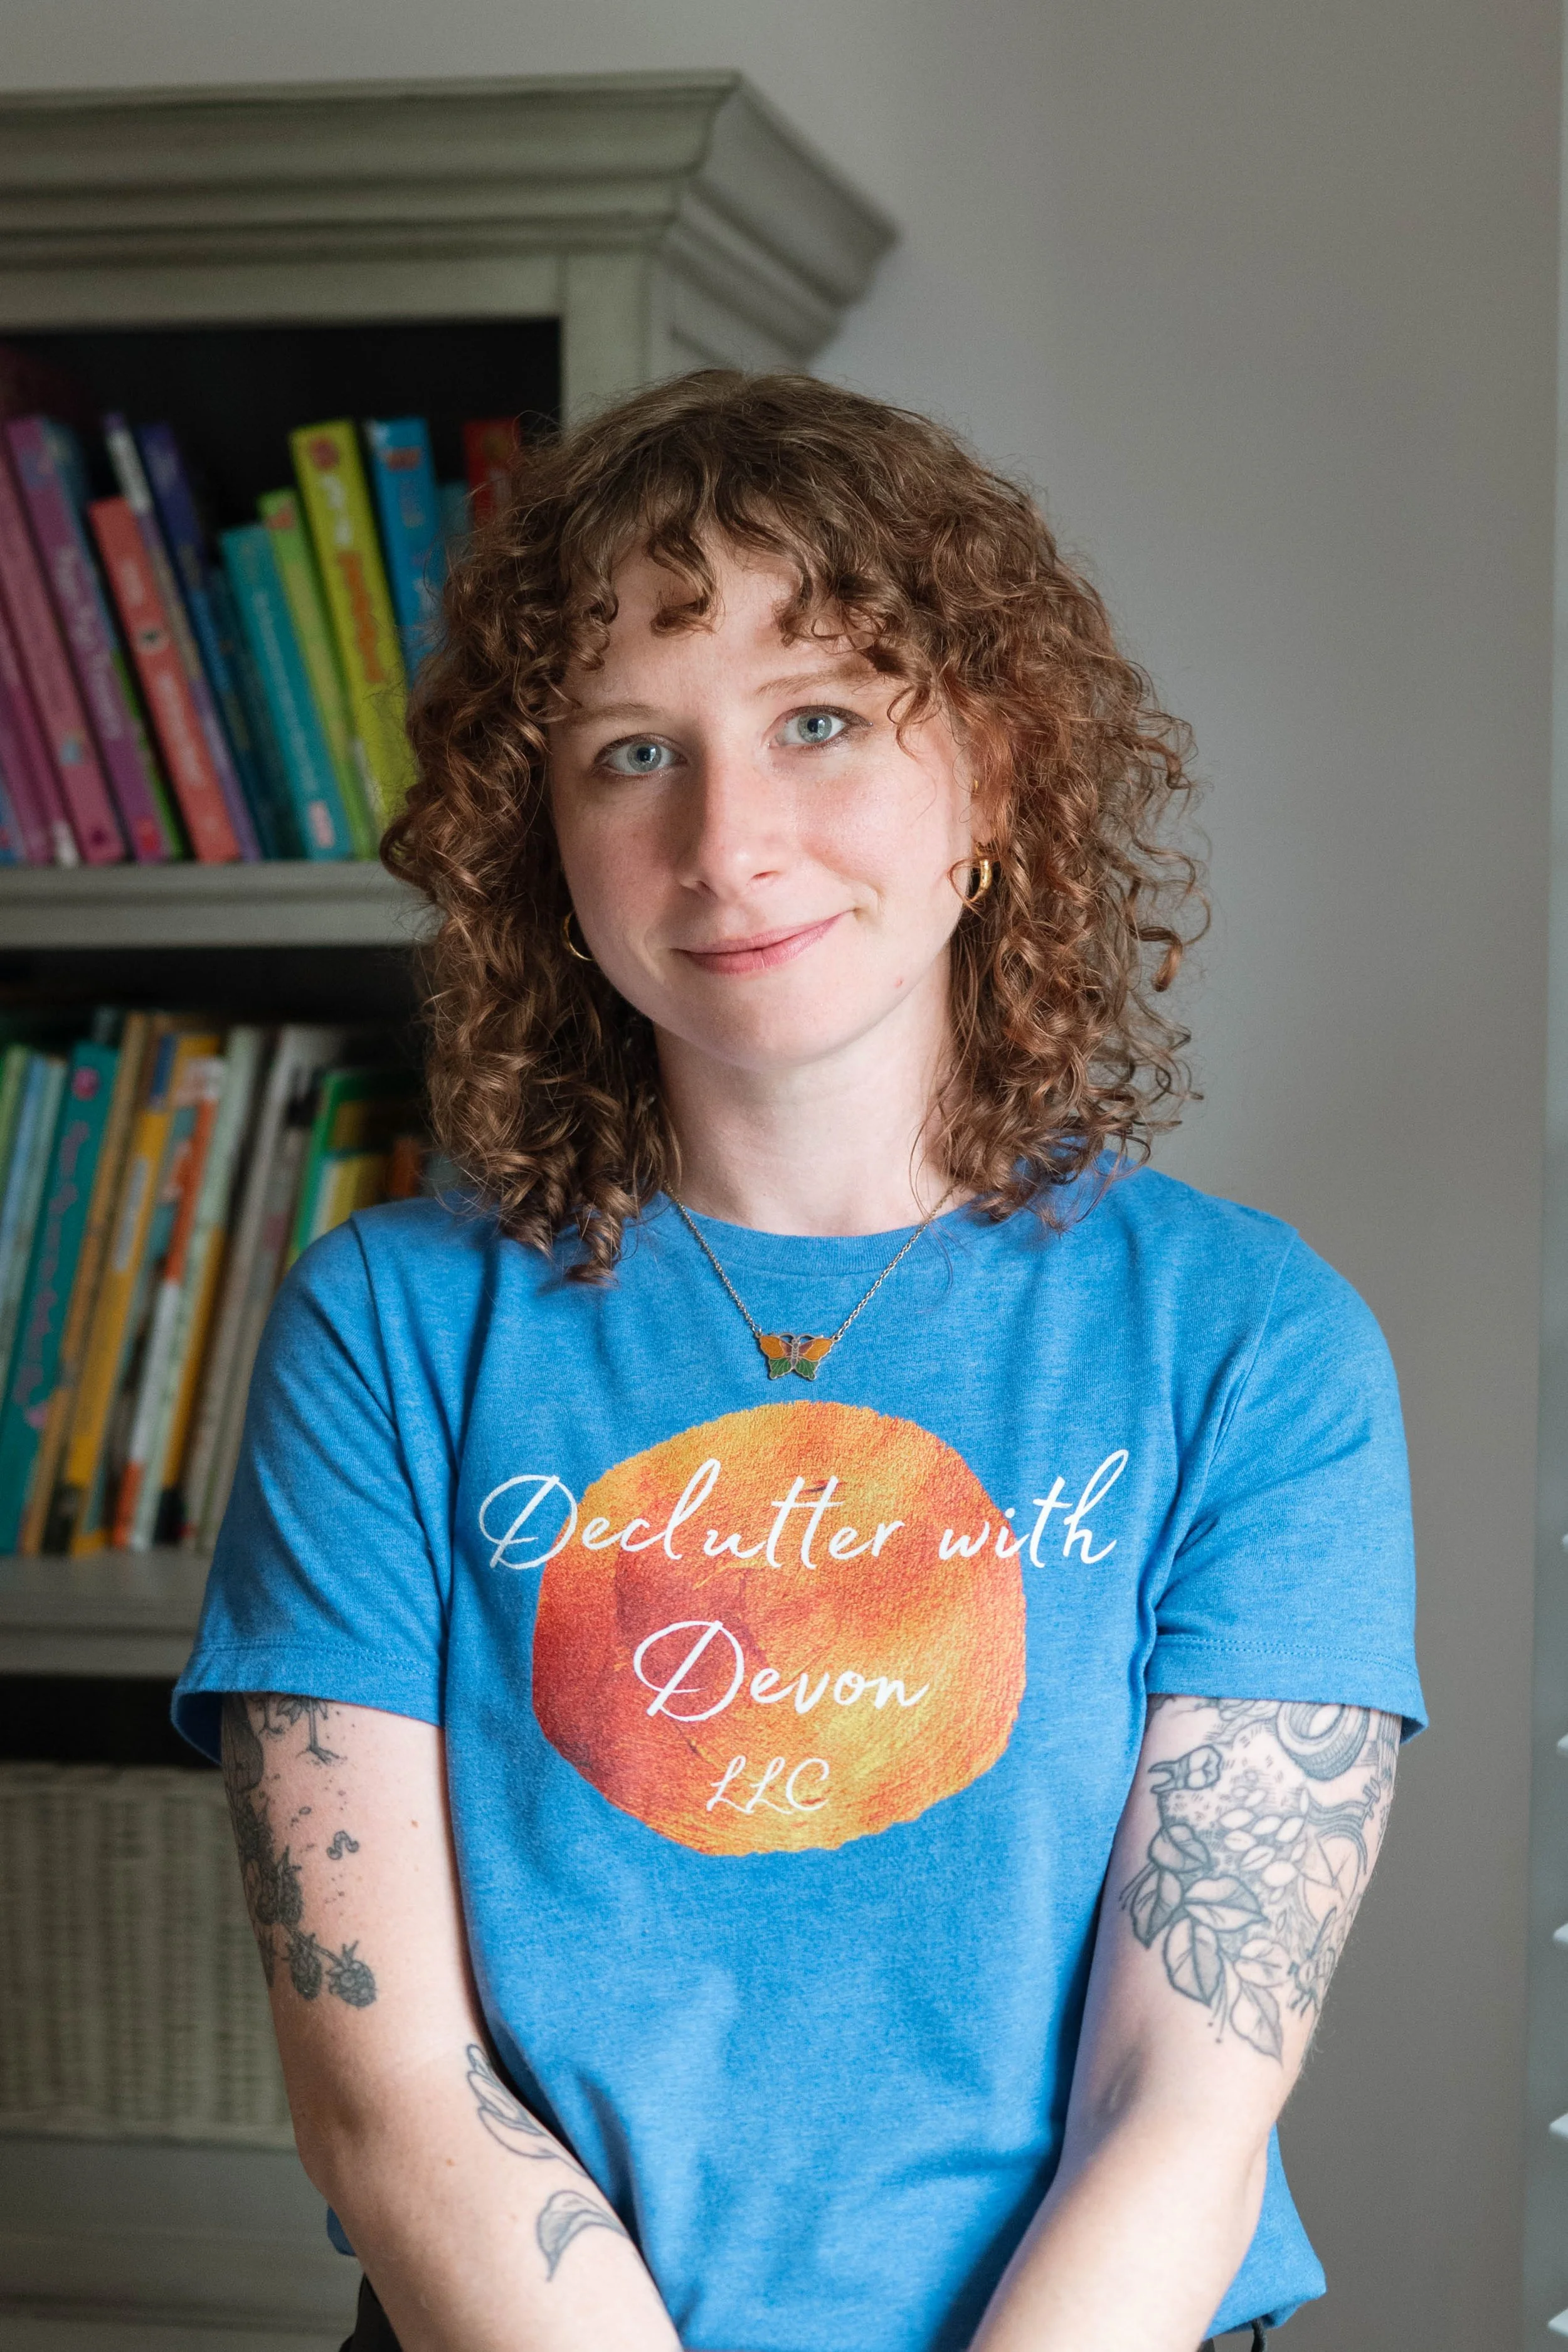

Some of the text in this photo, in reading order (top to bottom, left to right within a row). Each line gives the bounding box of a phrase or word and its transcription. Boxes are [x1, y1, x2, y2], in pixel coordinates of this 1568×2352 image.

[479, 1448, 1130, 1570] Declutter with
[633, 1619, 930, 1722] Devon
[706, 1755, 831, 1814] LLC
